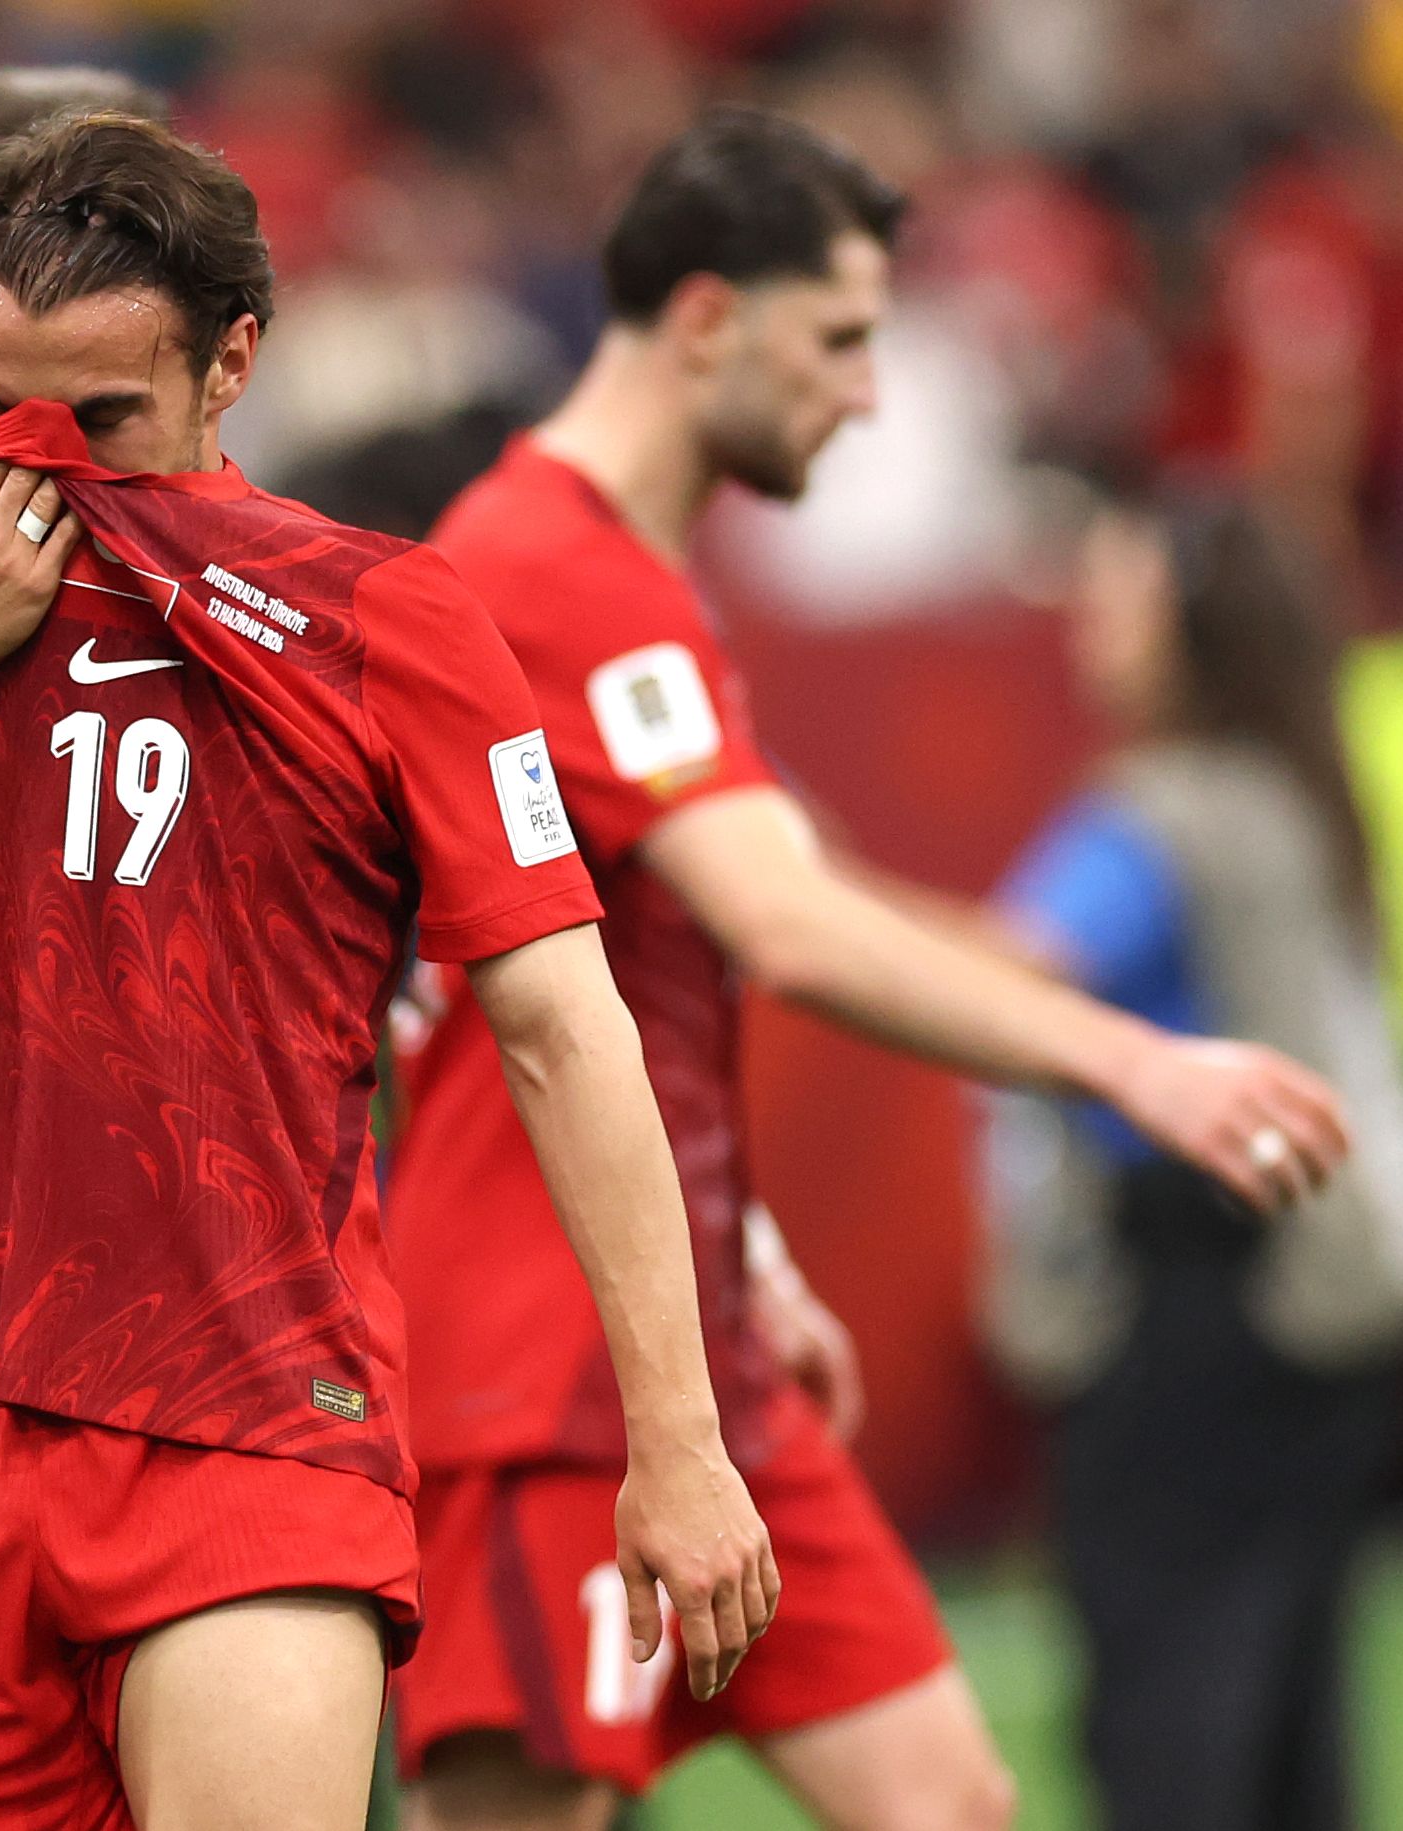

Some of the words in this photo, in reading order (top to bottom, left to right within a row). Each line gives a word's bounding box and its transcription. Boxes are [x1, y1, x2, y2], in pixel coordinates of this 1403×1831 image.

[199, 562, 311, 637] AVUSTRALYA-TÜRKİYE
[206, 596, 223, 620] 13
[216, 602, 264, 642] HAZİRAN
[258, 625, 285, 654] 2026
[50, 710, 190, 887] 19
